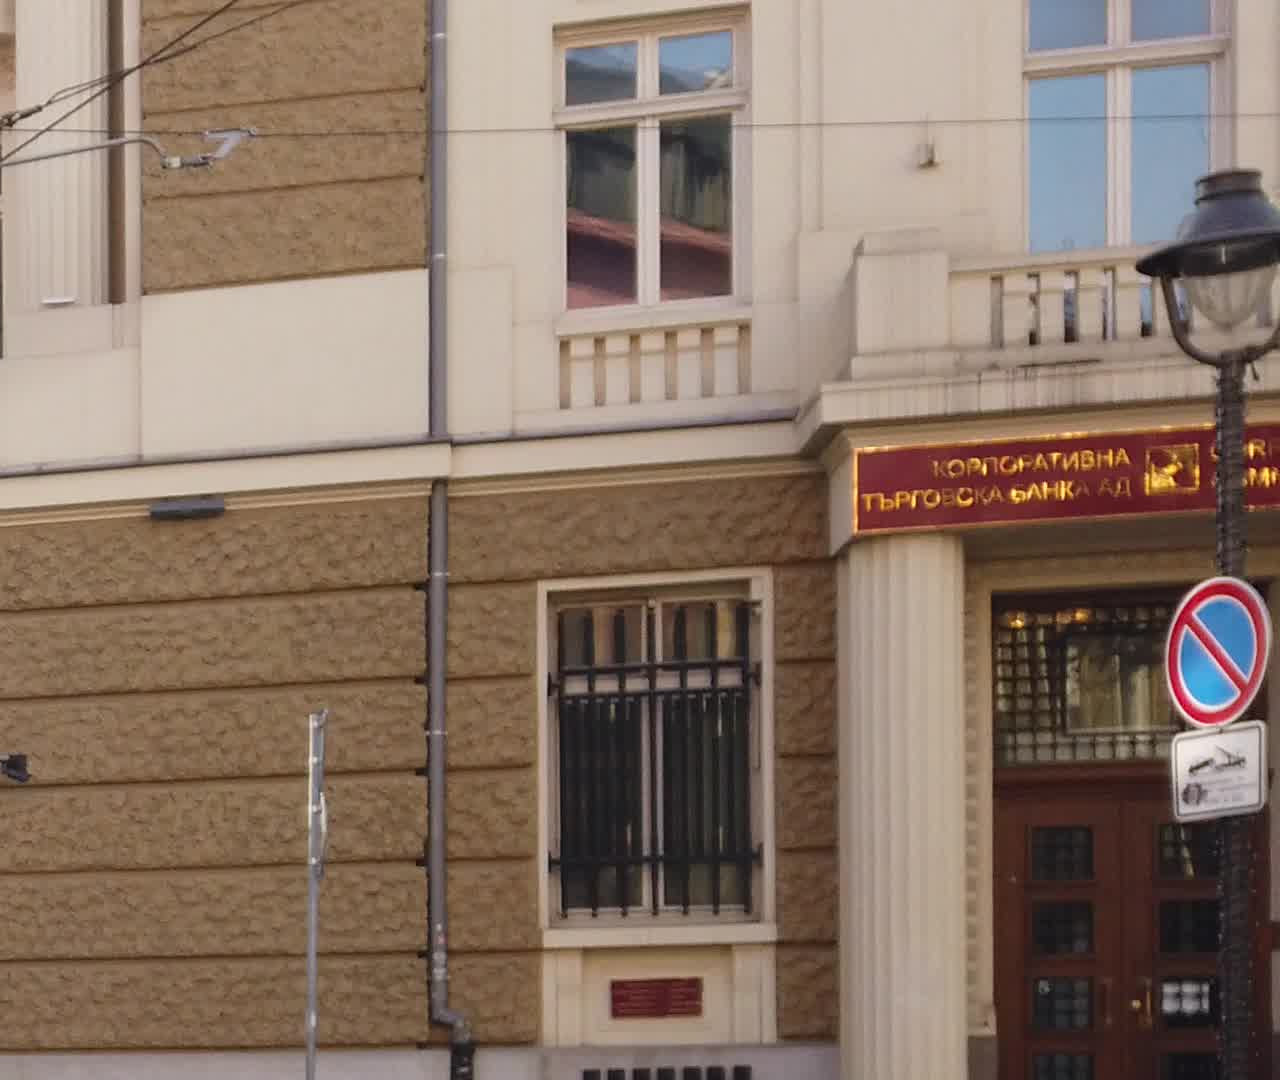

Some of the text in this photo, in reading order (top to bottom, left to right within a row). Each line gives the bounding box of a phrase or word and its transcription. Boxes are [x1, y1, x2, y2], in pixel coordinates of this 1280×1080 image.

[932, 447, 1132, 478] КОРПОРАТИВНА
[861, 476, 1132, 513] ТЪРГОВСКА БАНКА АД
